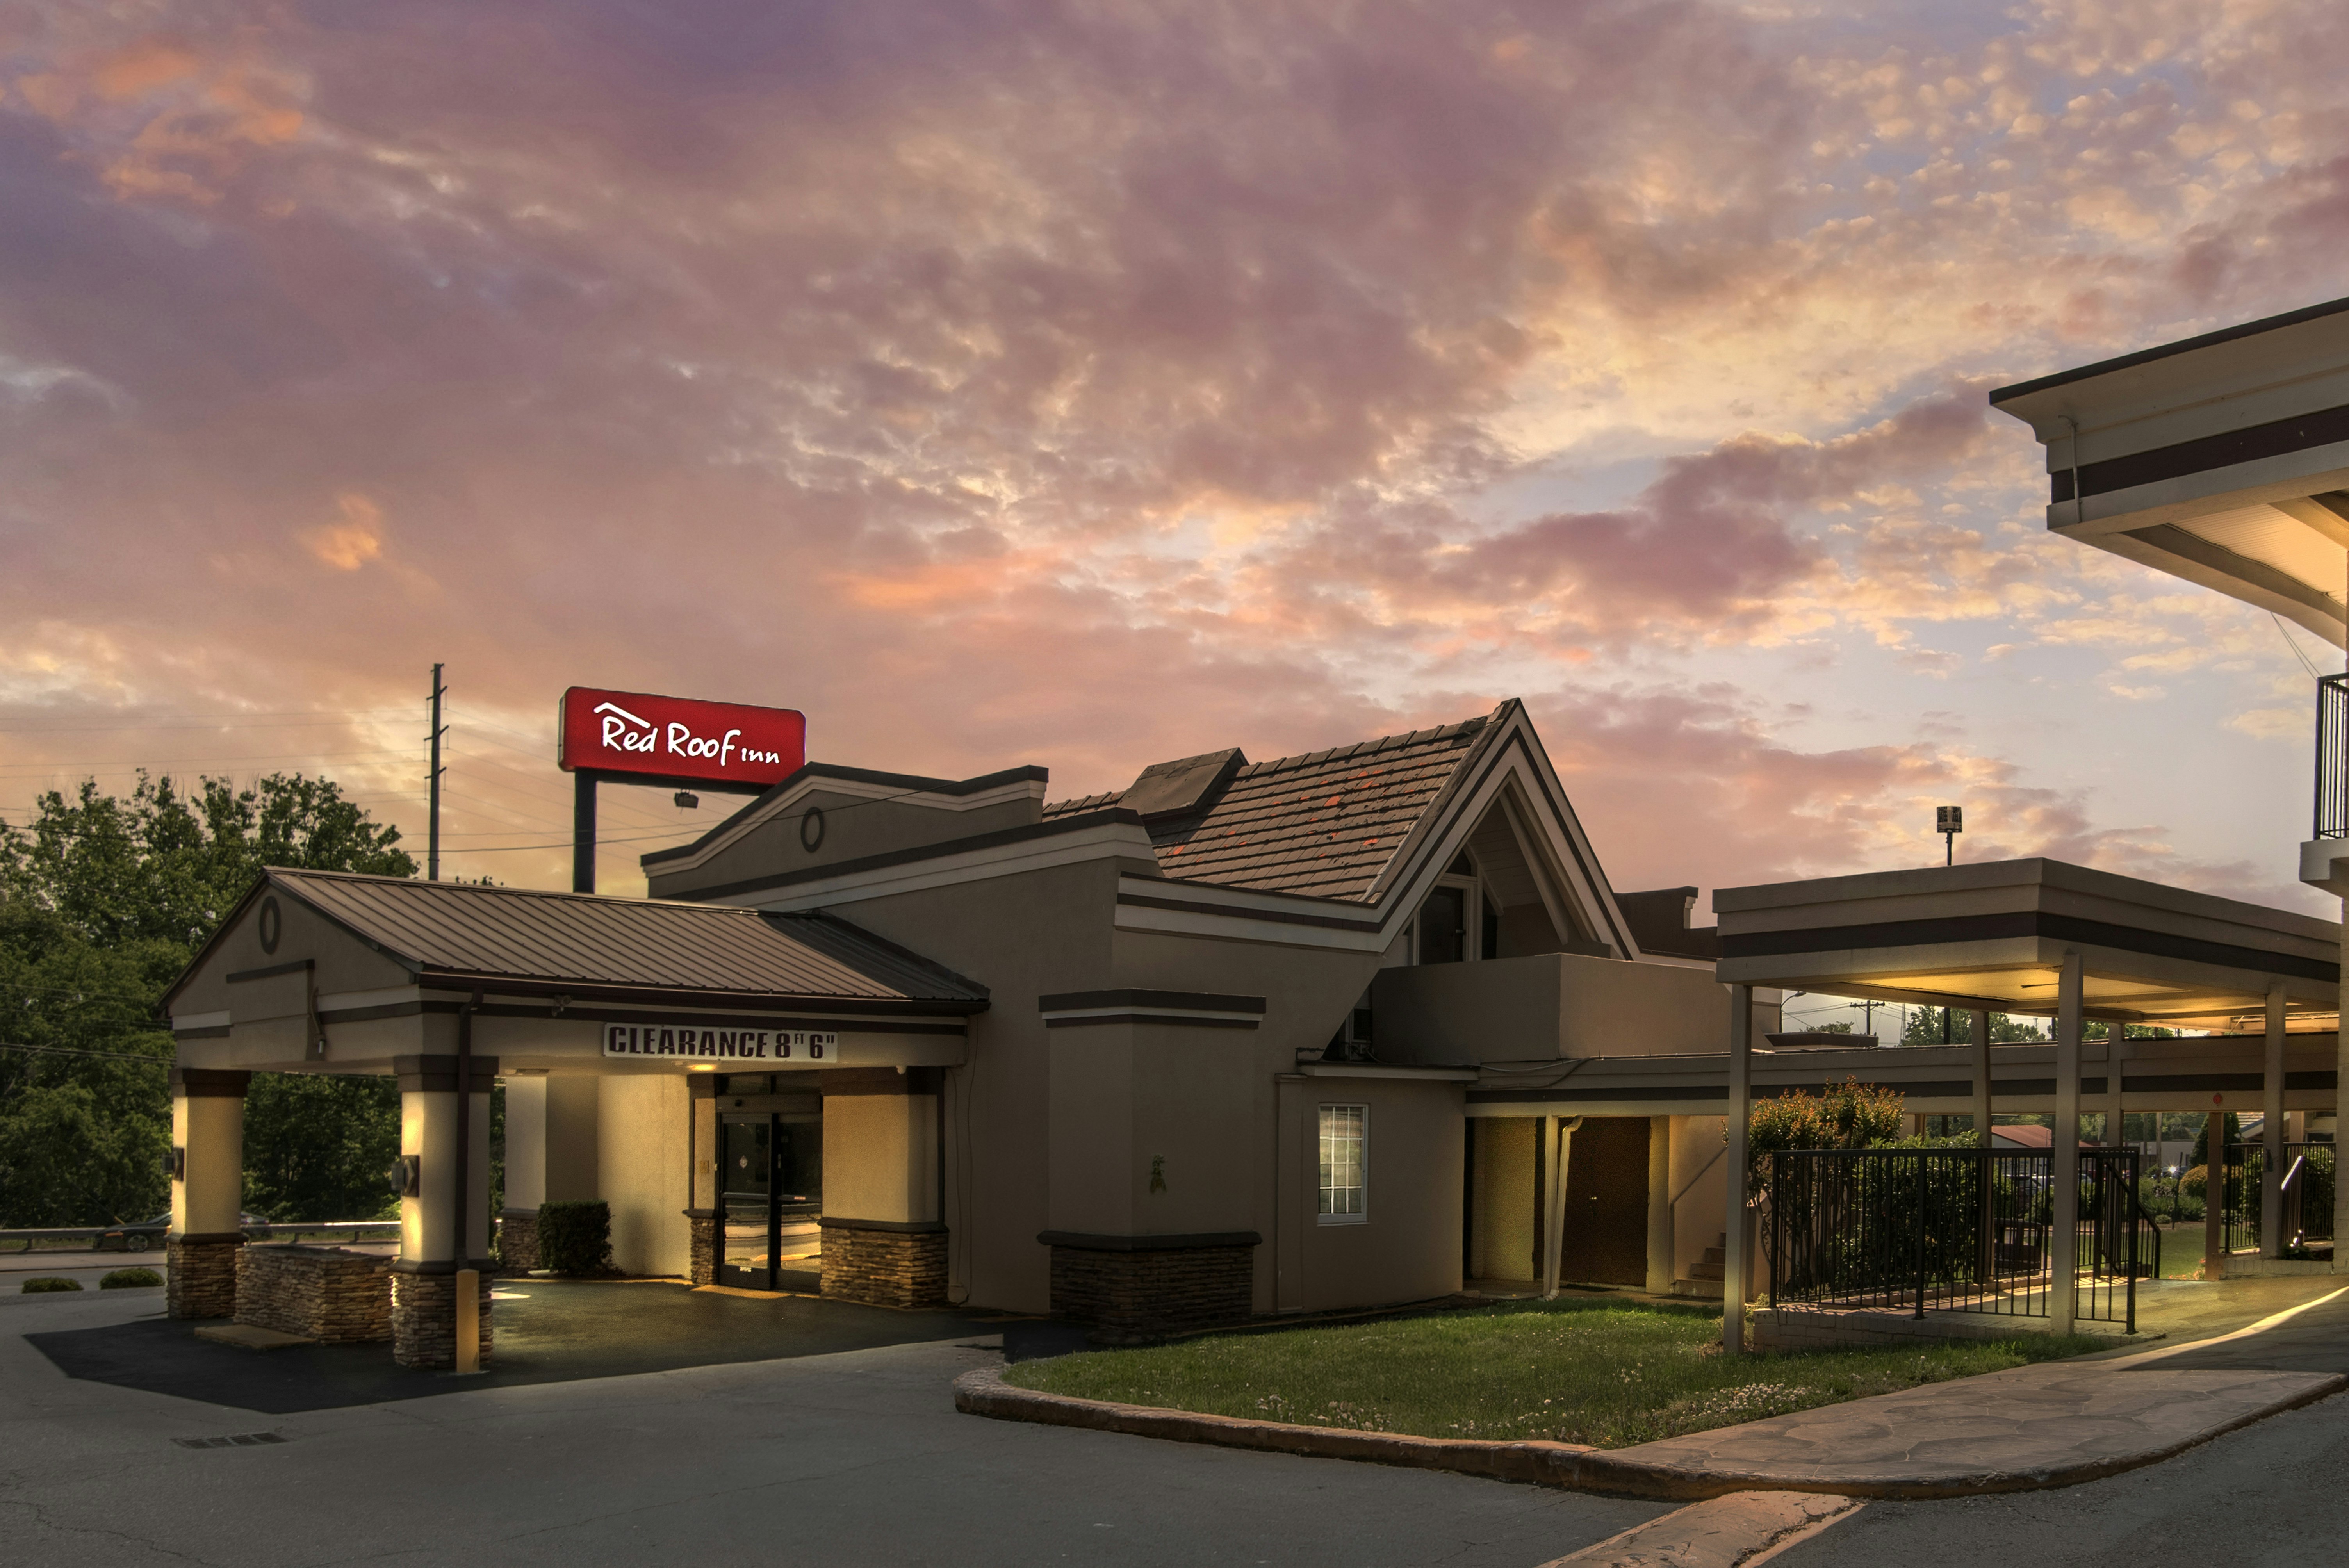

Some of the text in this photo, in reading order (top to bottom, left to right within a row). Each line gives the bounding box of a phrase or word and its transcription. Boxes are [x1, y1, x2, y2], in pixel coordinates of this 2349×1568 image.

[602, 716, 658, 752] Red
[667, 722, 741, 766] Roof
[609, 1026, 768, 1058] CLEARANCE
